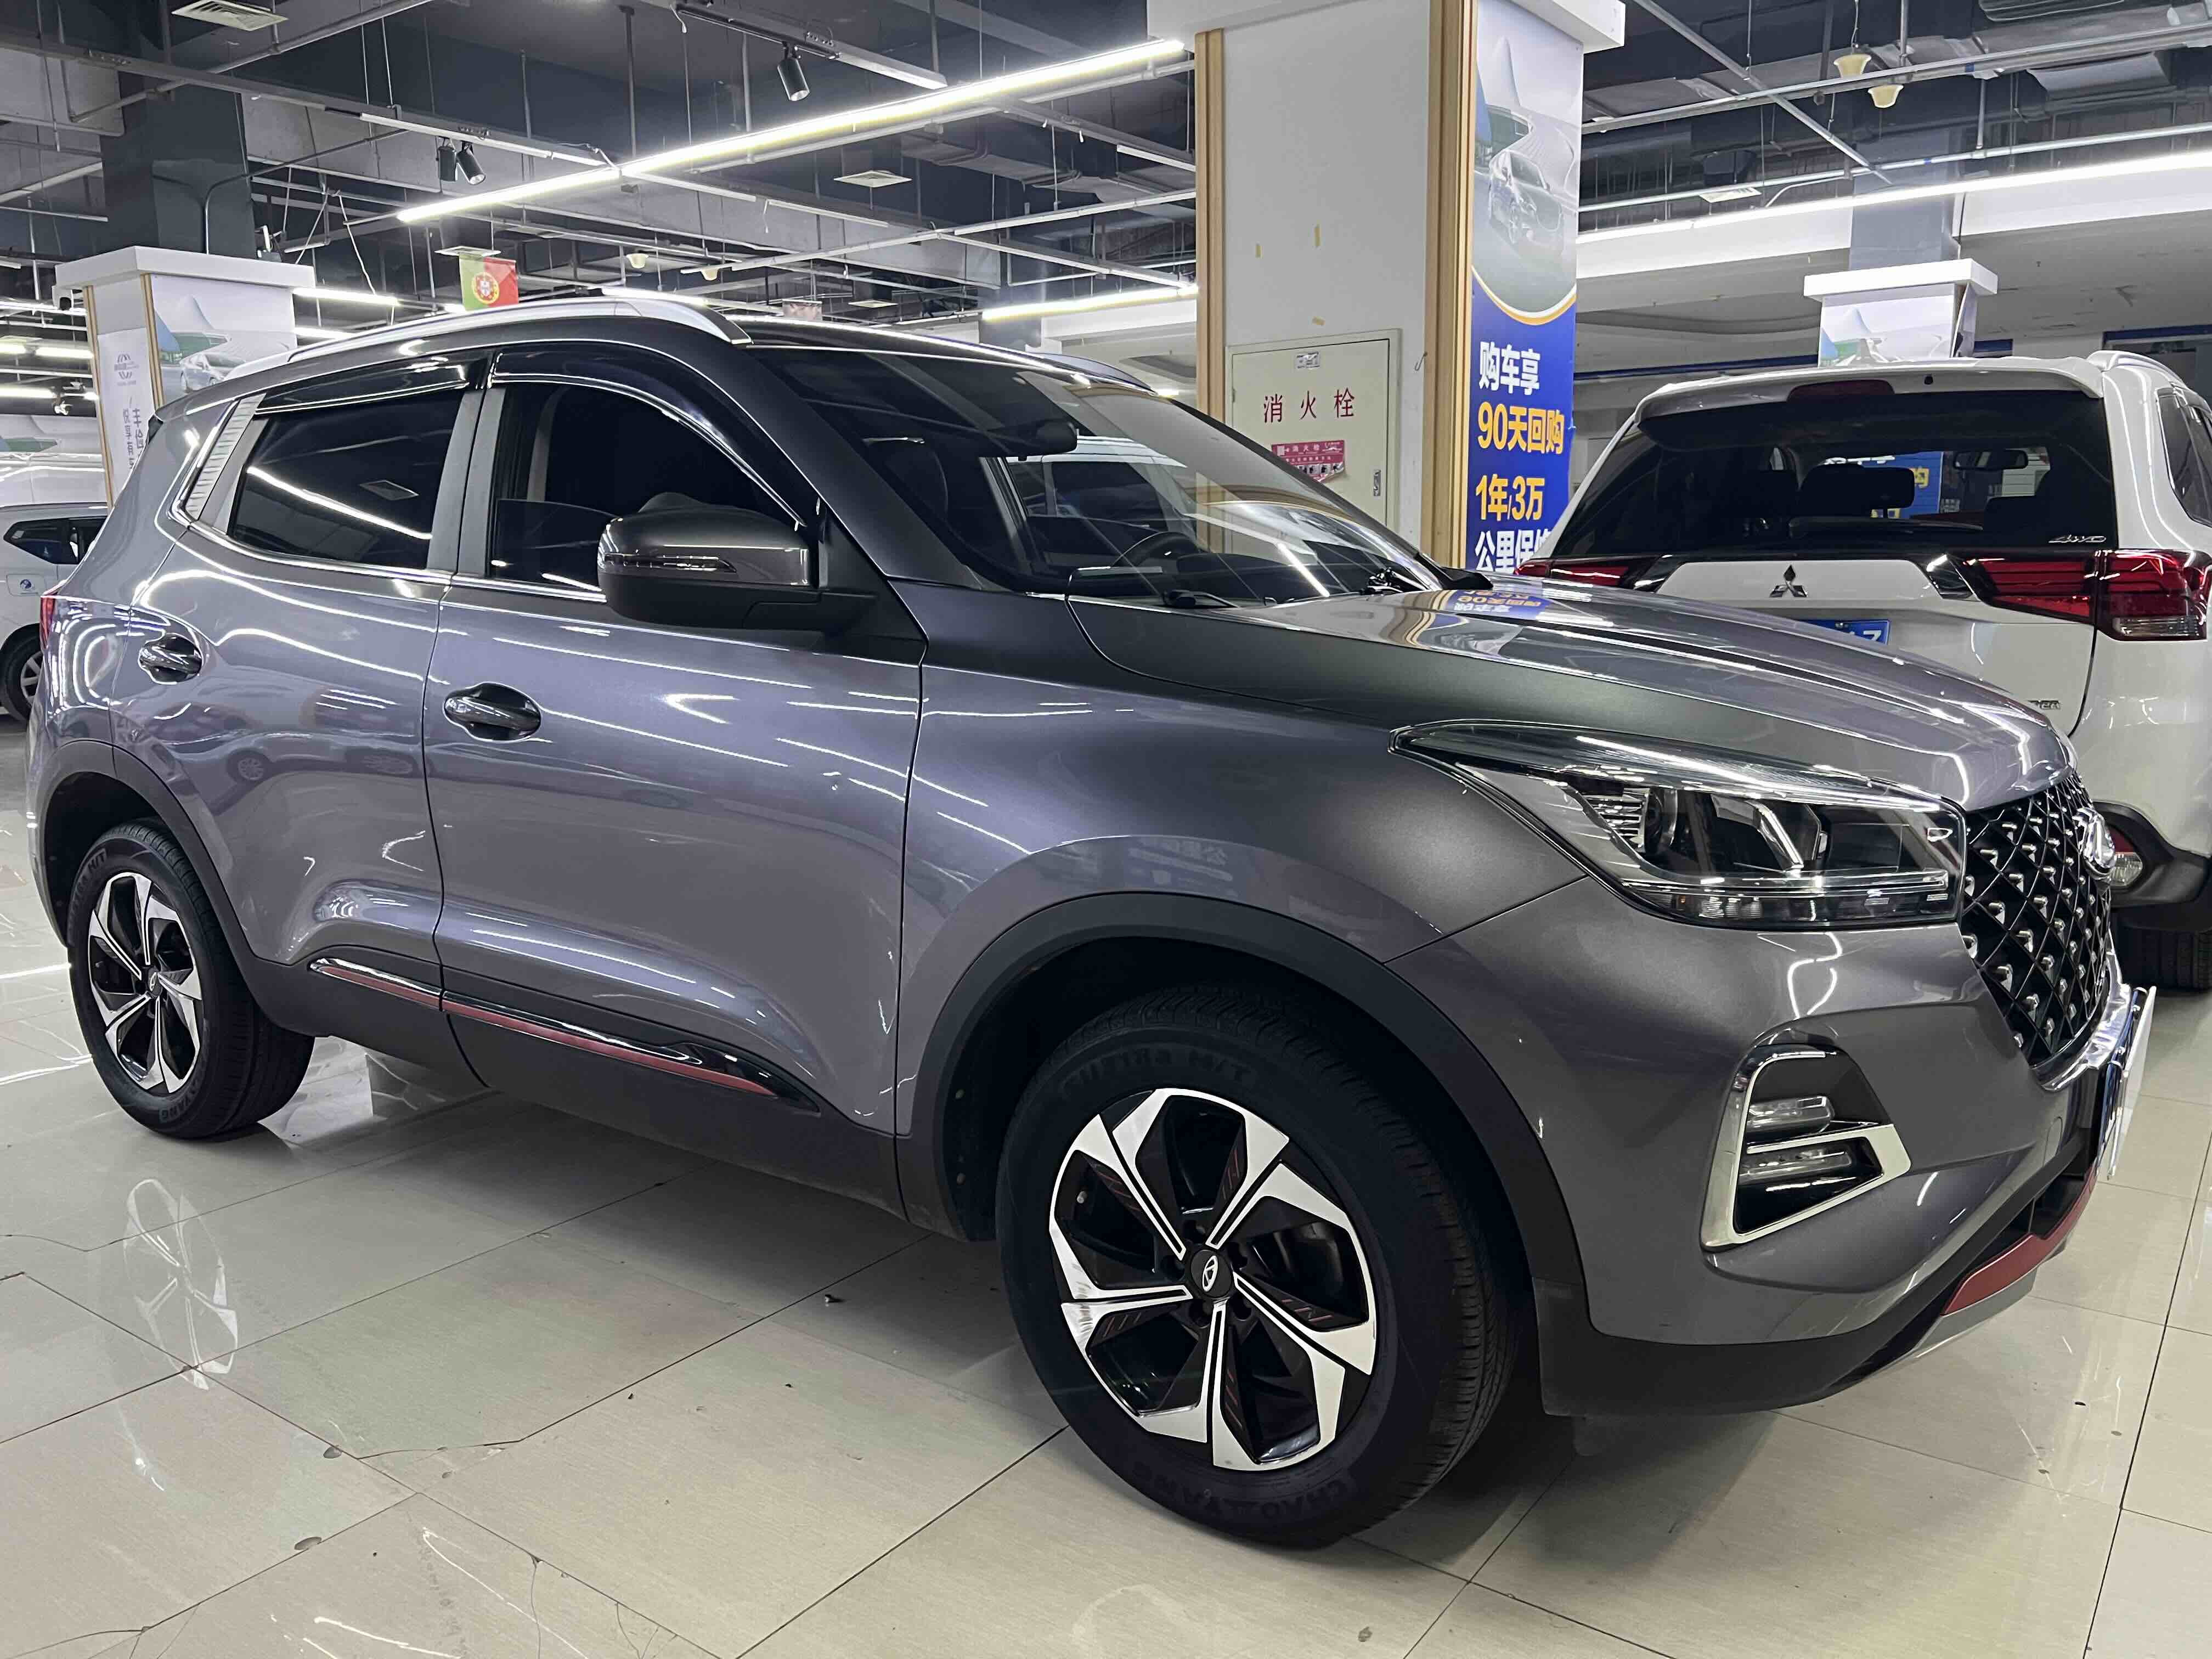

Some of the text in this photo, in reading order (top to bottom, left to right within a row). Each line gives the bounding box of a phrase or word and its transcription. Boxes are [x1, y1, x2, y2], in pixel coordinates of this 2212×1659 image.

[1479, 341, 1541, 395] 购车享
[1263, 387, 1355, 423] 消火栓
[1477, 402, 1565, 454] 90天回购
[1476, 473, 1545, 521] 1年/3万
